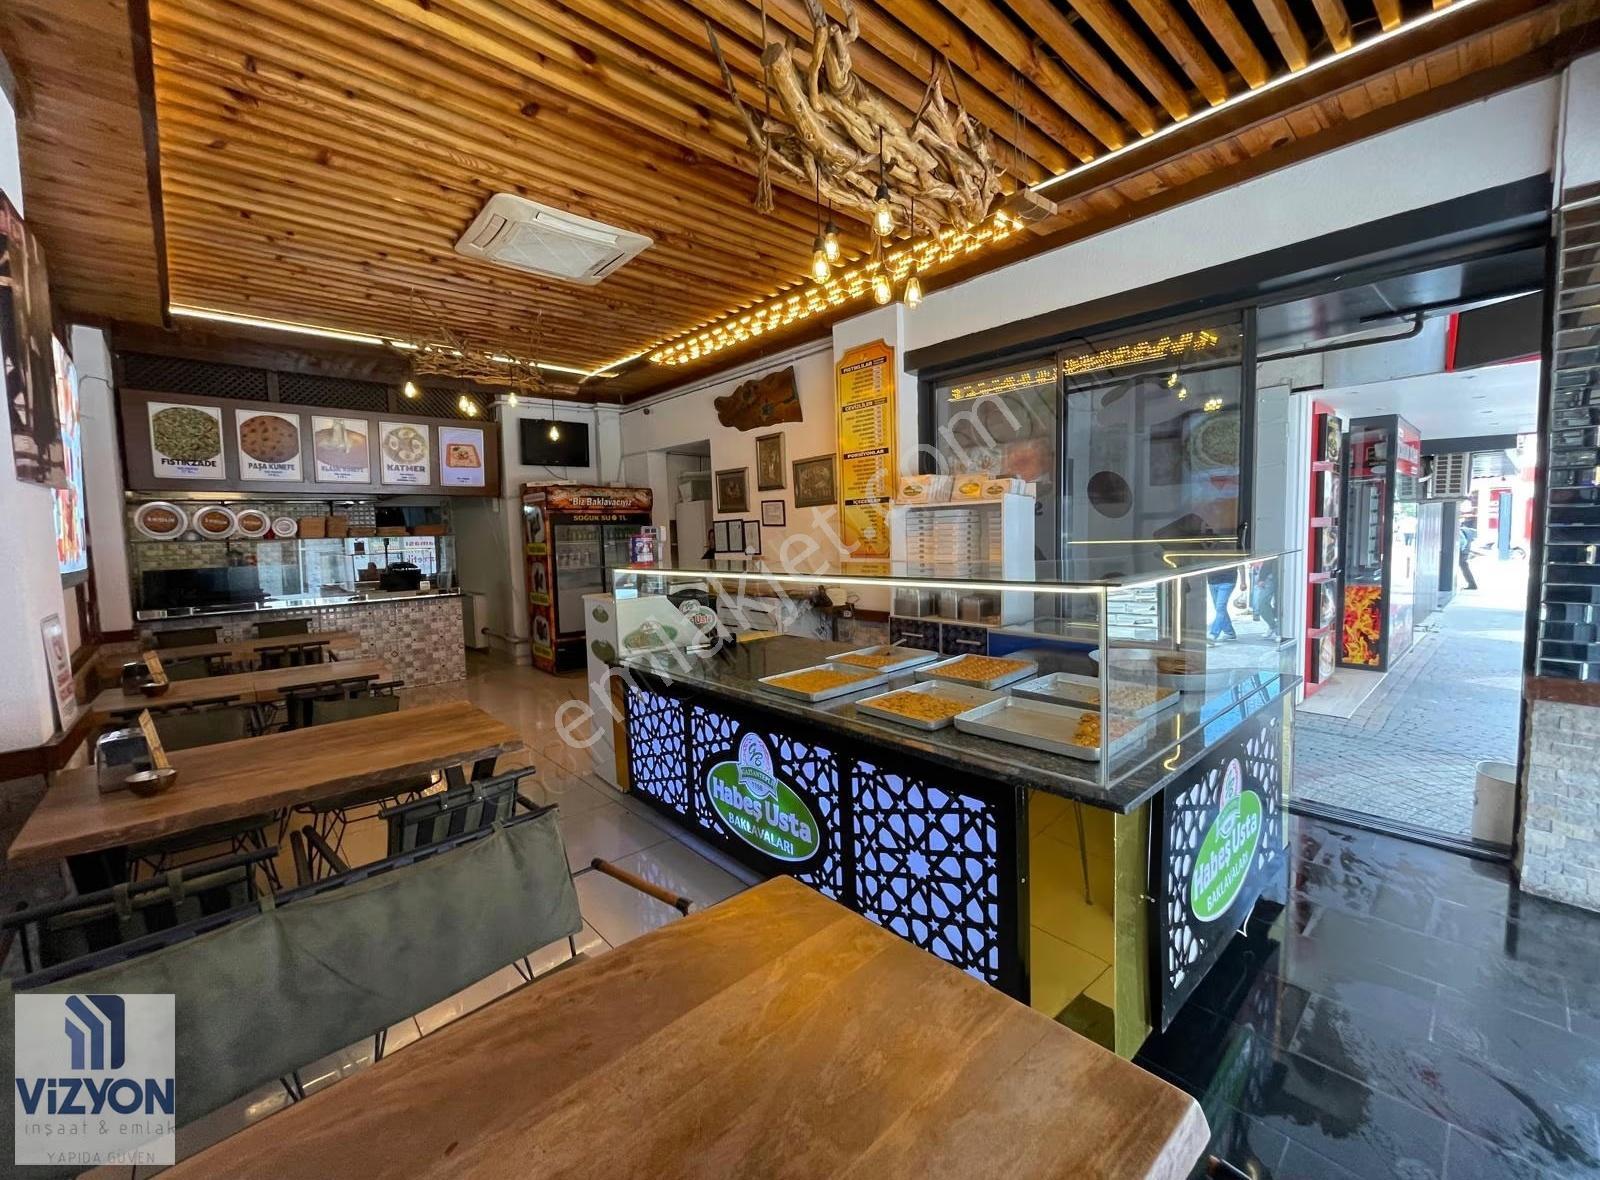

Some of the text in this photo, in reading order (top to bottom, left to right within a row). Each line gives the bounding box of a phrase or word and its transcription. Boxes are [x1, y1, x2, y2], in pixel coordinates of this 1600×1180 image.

[386, 464, 426, 473] KATMER
[712, 777, 813, 844] Habeş Usta
[728, 812, 794, 855] BAKLAVALARI
[1193, 812, 1258, 900] Habeş Usta
[1206, 850, 1250, 912] BAKLAVALARI
